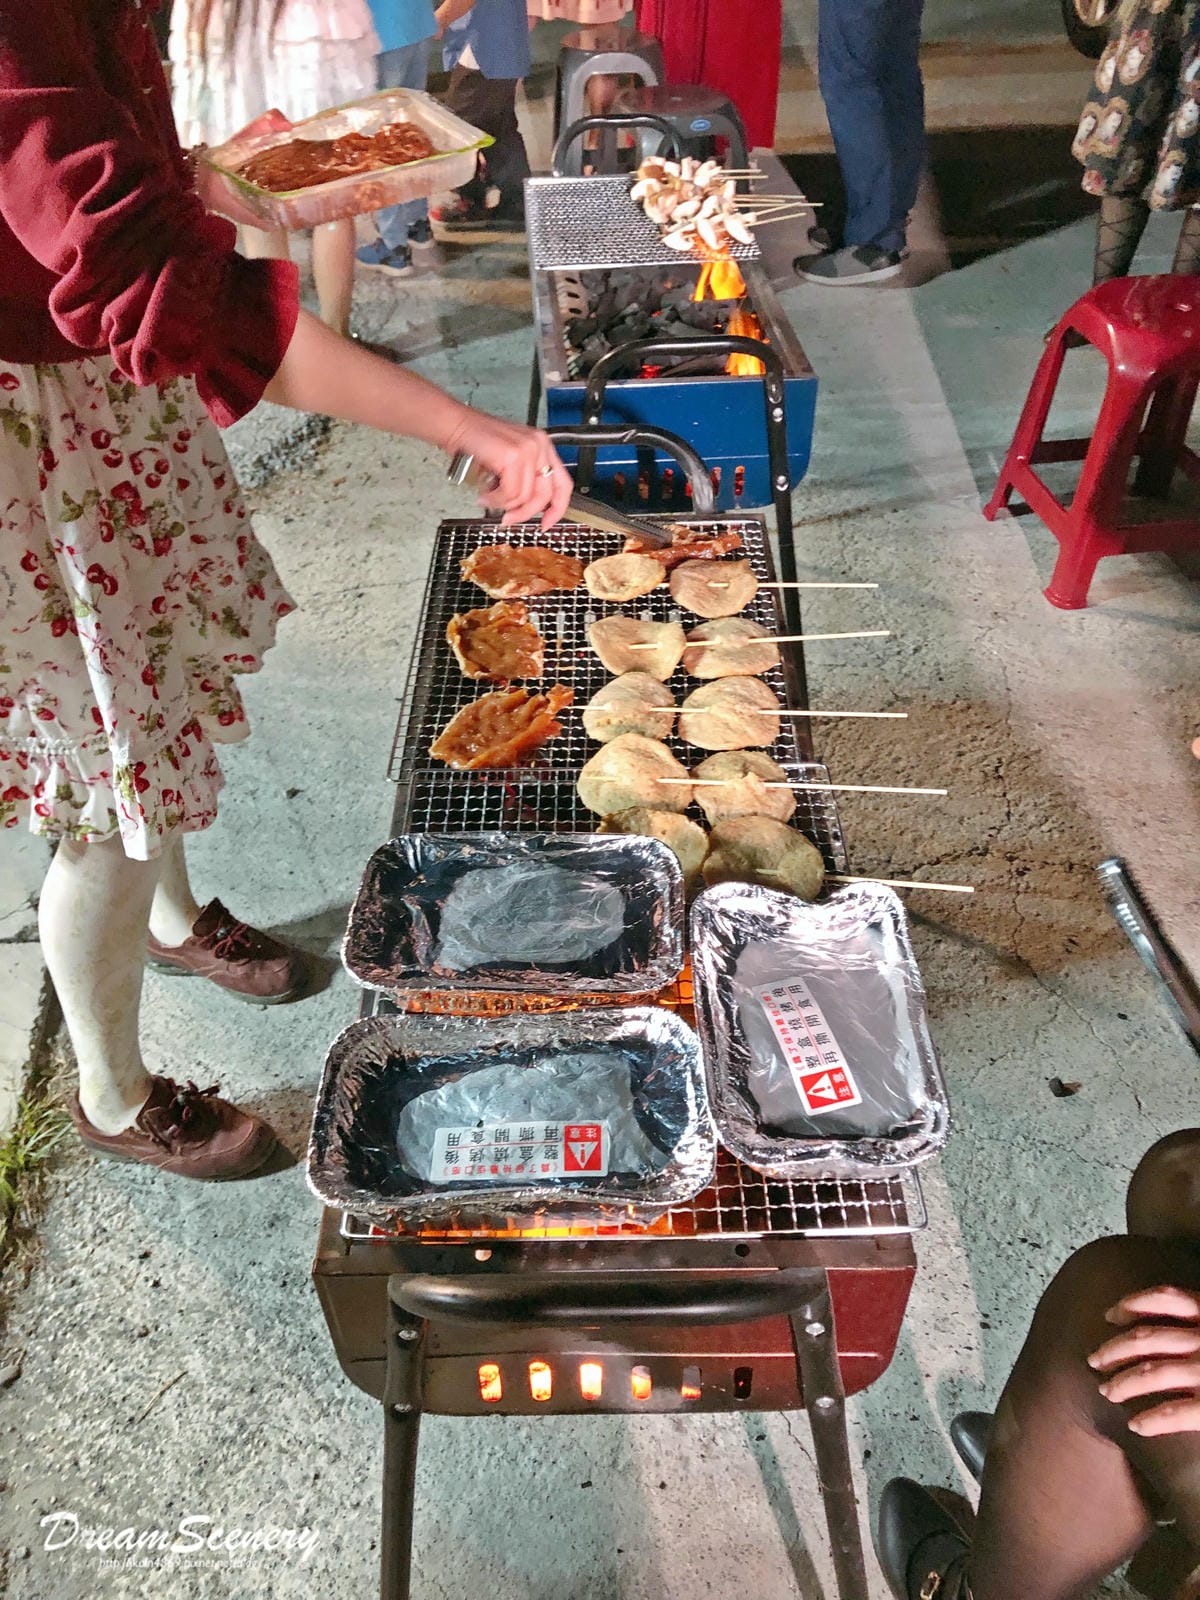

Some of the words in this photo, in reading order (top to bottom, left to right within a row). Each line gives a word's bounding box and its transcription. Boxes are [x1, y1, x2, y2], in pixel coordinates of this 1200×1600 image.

[771, 986, 822, 1069] 整盒燒烤後
[787, 984, 839, 1064] 再撕開食用
[832, 1072, 852, 1097] 注意
[447, 1124, 560, 1147] 再撕開食用
[569, 1127, 598, 1139] 注意
[445, 1144, 560, 1165] 整盒燒烤後
